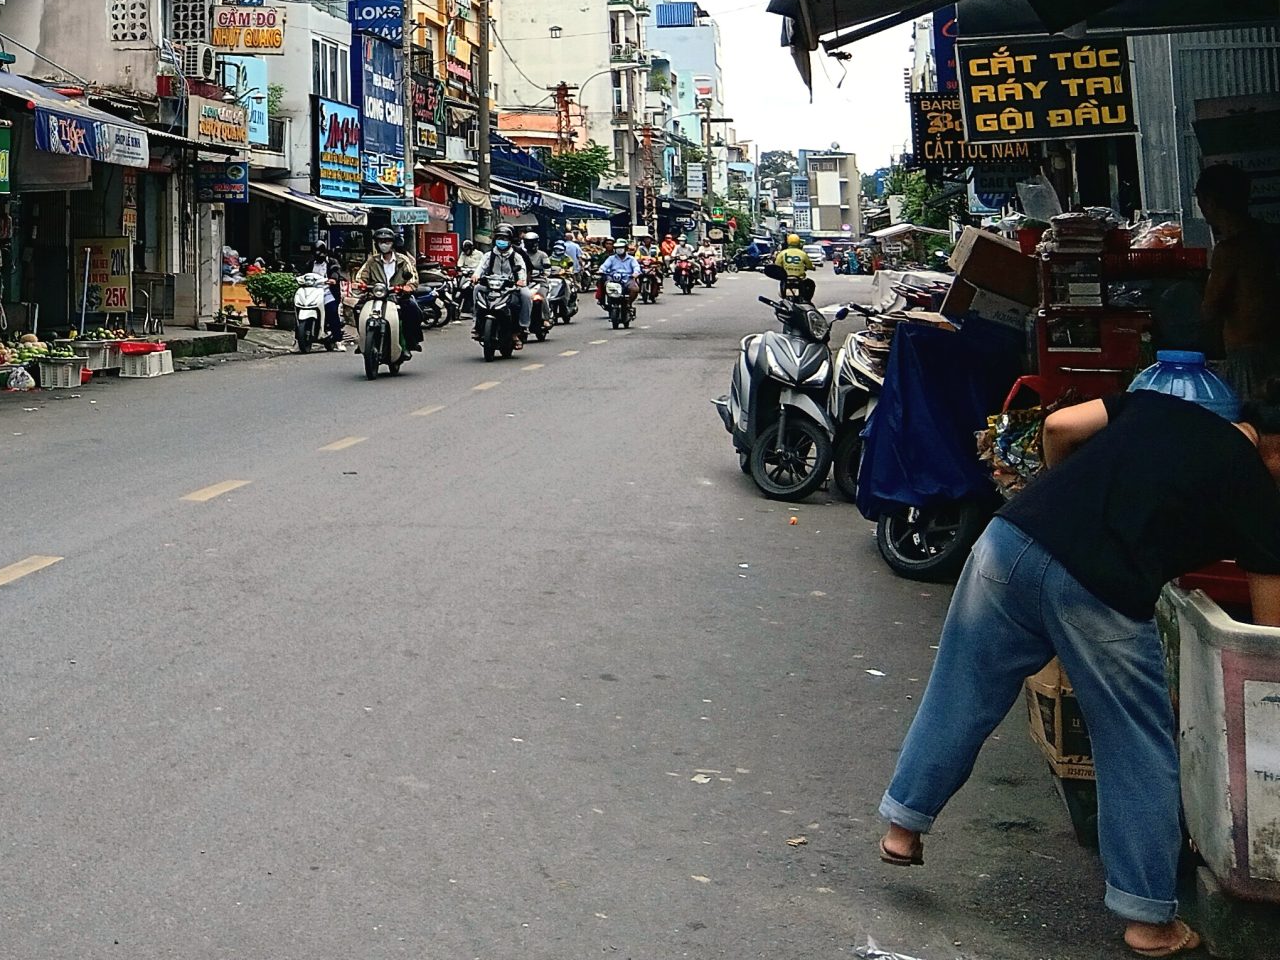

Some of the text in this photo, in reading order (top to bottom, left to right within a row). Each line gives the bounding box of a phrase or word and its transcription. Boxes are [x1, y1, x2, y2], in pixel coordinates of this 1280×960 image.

[218, 6, 278, 27] CẦM ĐỒ
[355, 6, 402, 21] LONG
[243, 28, 282, 48] QUANG
[969, 45, 1120, 77] CẮT TÓC
[971, 74, 1123, 103] RÁY TAI
[364, 95, 384, 121] LONG
[385, 98, 404, 127] CHÂU
[975, 98, 1127, 134] GỘI ĐẦU
[59, 118, 85, 152] Tiger
[924, 134, 1029, 160] CẮT NAM
[784, 252, 801, 263] be
[105, 287, 127, 307] 25K
